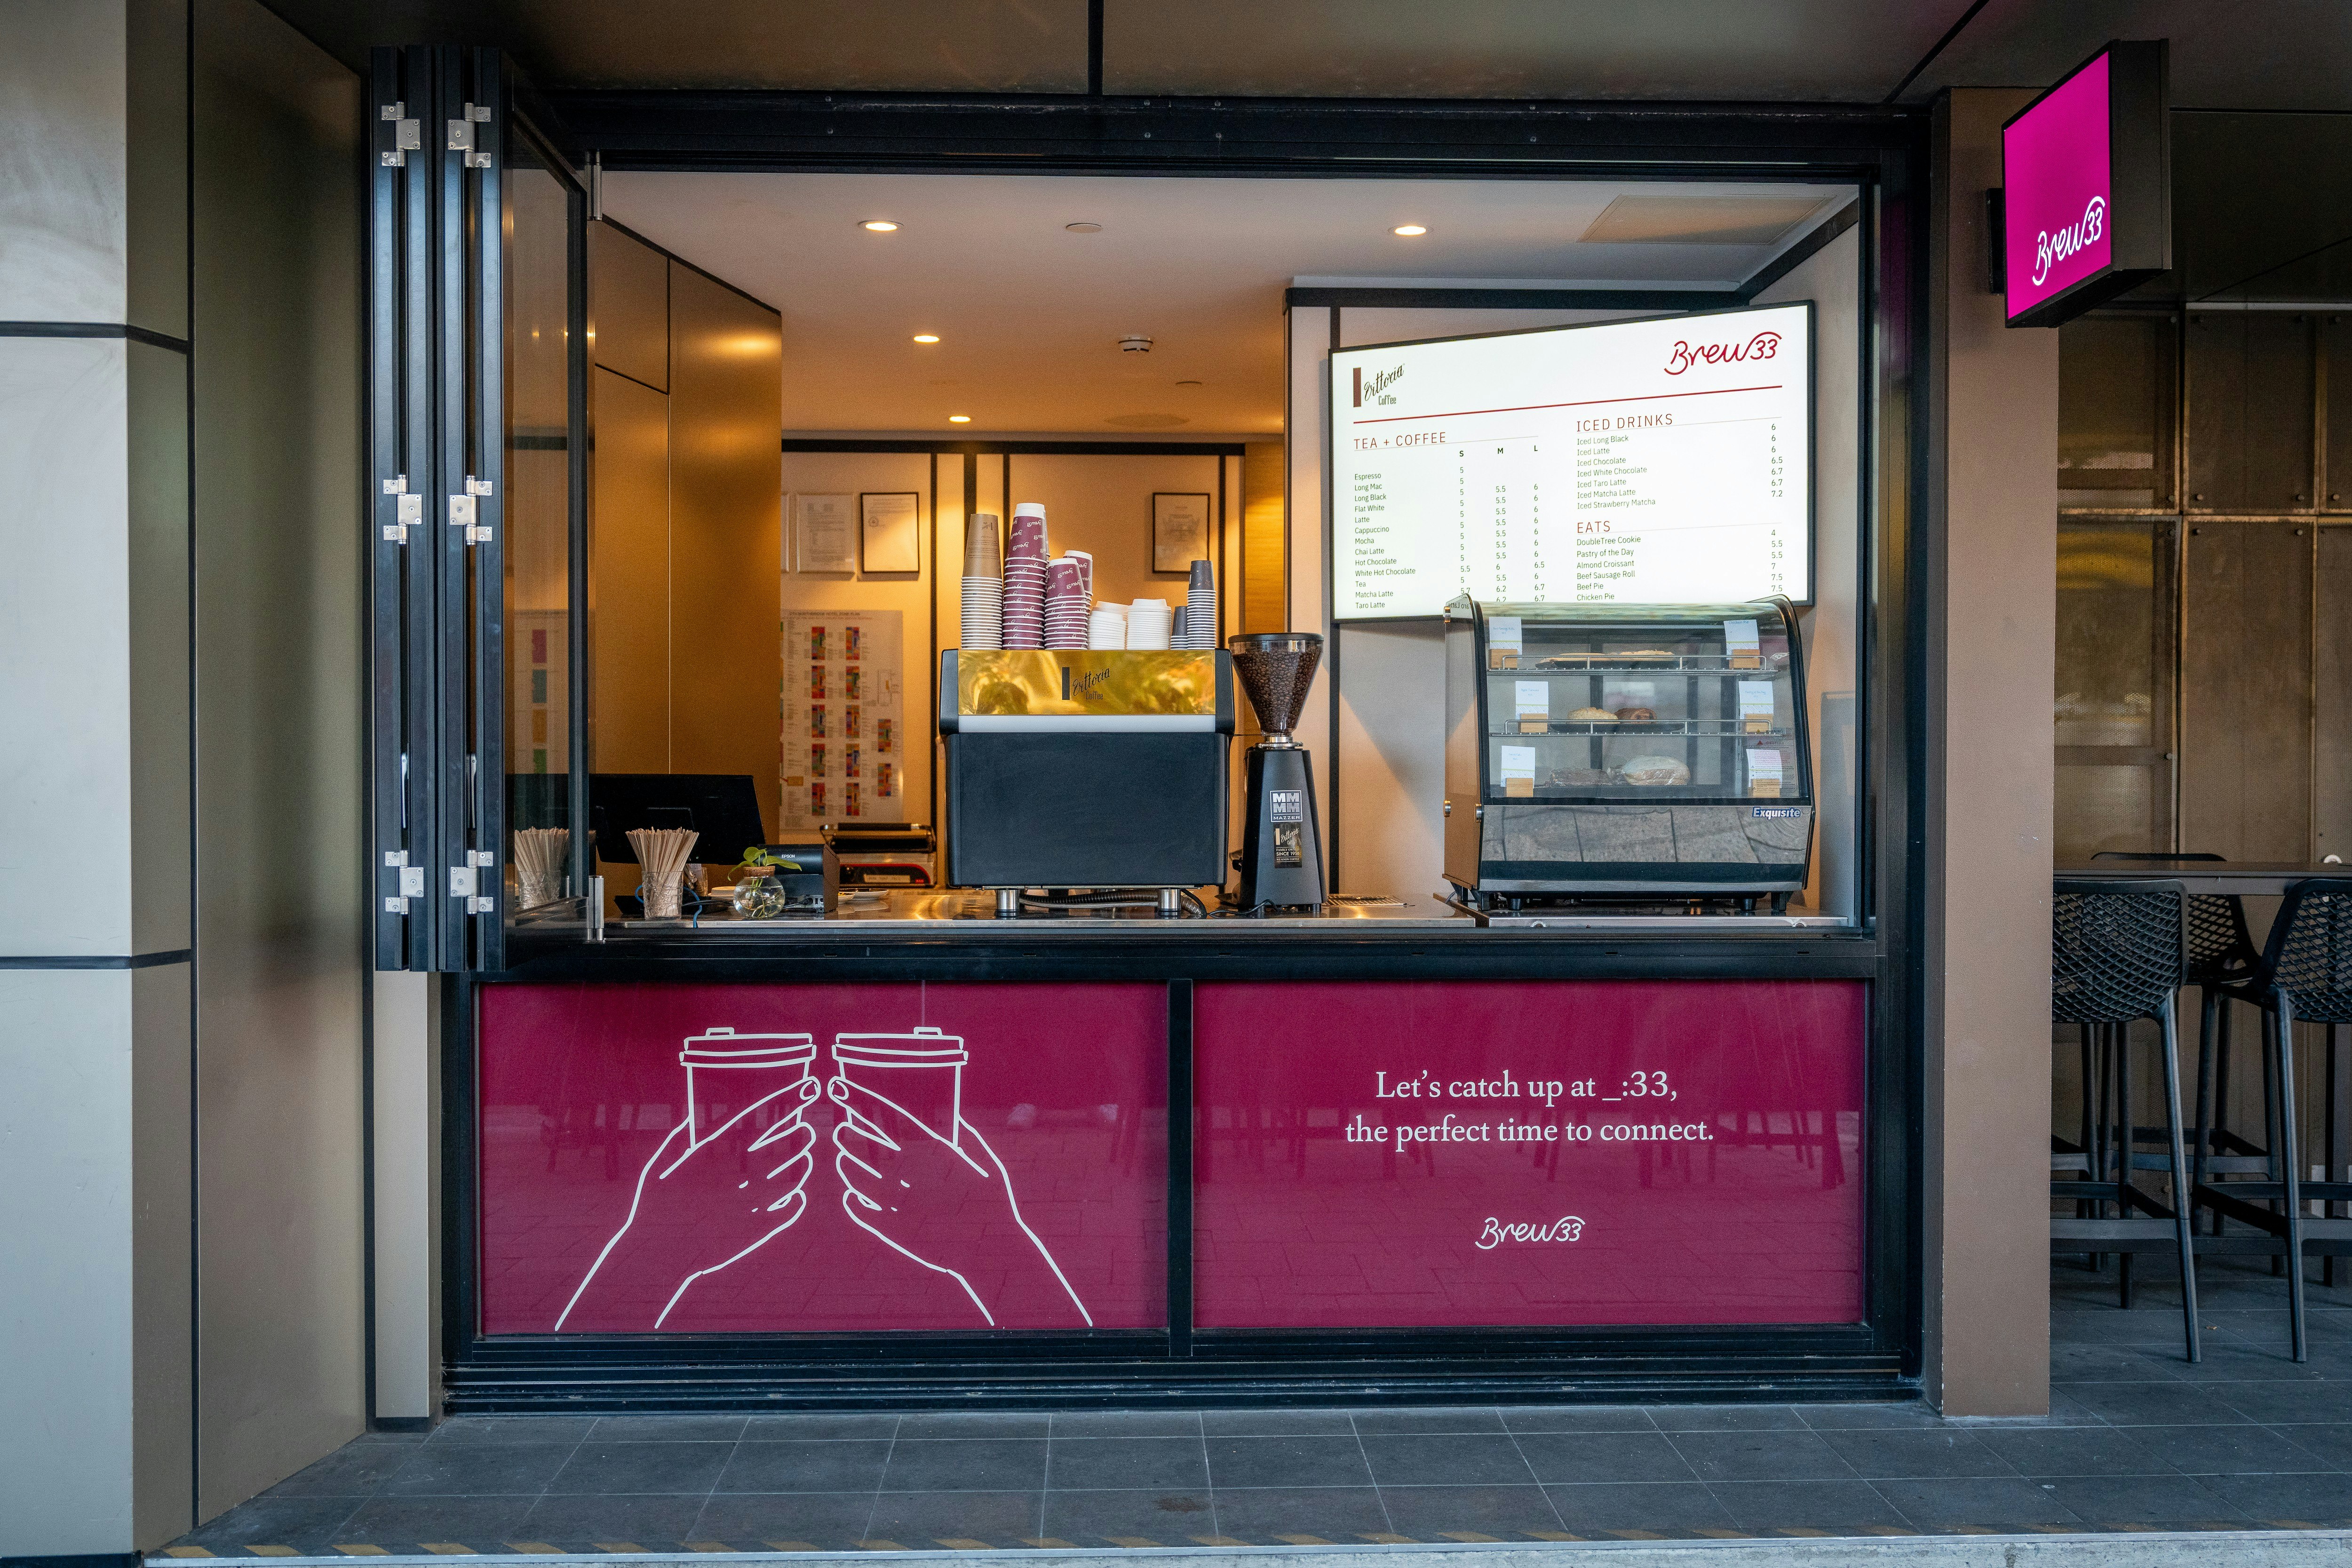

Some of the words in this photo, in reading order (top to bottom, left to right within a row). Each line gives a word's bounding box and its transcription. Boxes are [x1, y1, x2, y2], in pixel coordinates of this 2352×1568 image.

[2032, 196, 2106, 286] Brew33
[1664, 332, 1782, 375] Brew33
[1364, 365, 1404, 401] Vittoria
[1379, 395, 1396, 406] Coffee
[1577, 419, 1610, 432] ICED
[1617, 414, 1673, 429] DRINKS
[1354, 438, 1377, 449] TEA
[1396, 432, 1446, 446] COFFEE
[1355, 526, 1390, 534] Cappuccino
[1577, 521, 1611, 533] EATS
[1577, 537, 1615, 546] DoubleTree
[1618, 535, 1641, 544] Cookie
[1621, 549, 1634, 557] Day
[1073, 668, 1110, 696] Vittoria
[1086, 691, 1103, 700] Coffee
[1753, 807, 1801, 820] Exquisite
[1449, 1070, 1520, 1098] catch
[1528, 1081, 1564, 1107] up
[1572, 1078, 1596, 1098] at
[1345, 1114, 1388, 1143] the
[1396, 1114, 1490, 1153] perfect
[1497, 1118, 1558, 1142] time
[1565, 1122, 1592, 1141] to
[1600, 1122, 1714, 1141] connect.
[1475, 1216, 1586, 1250] Brew33
